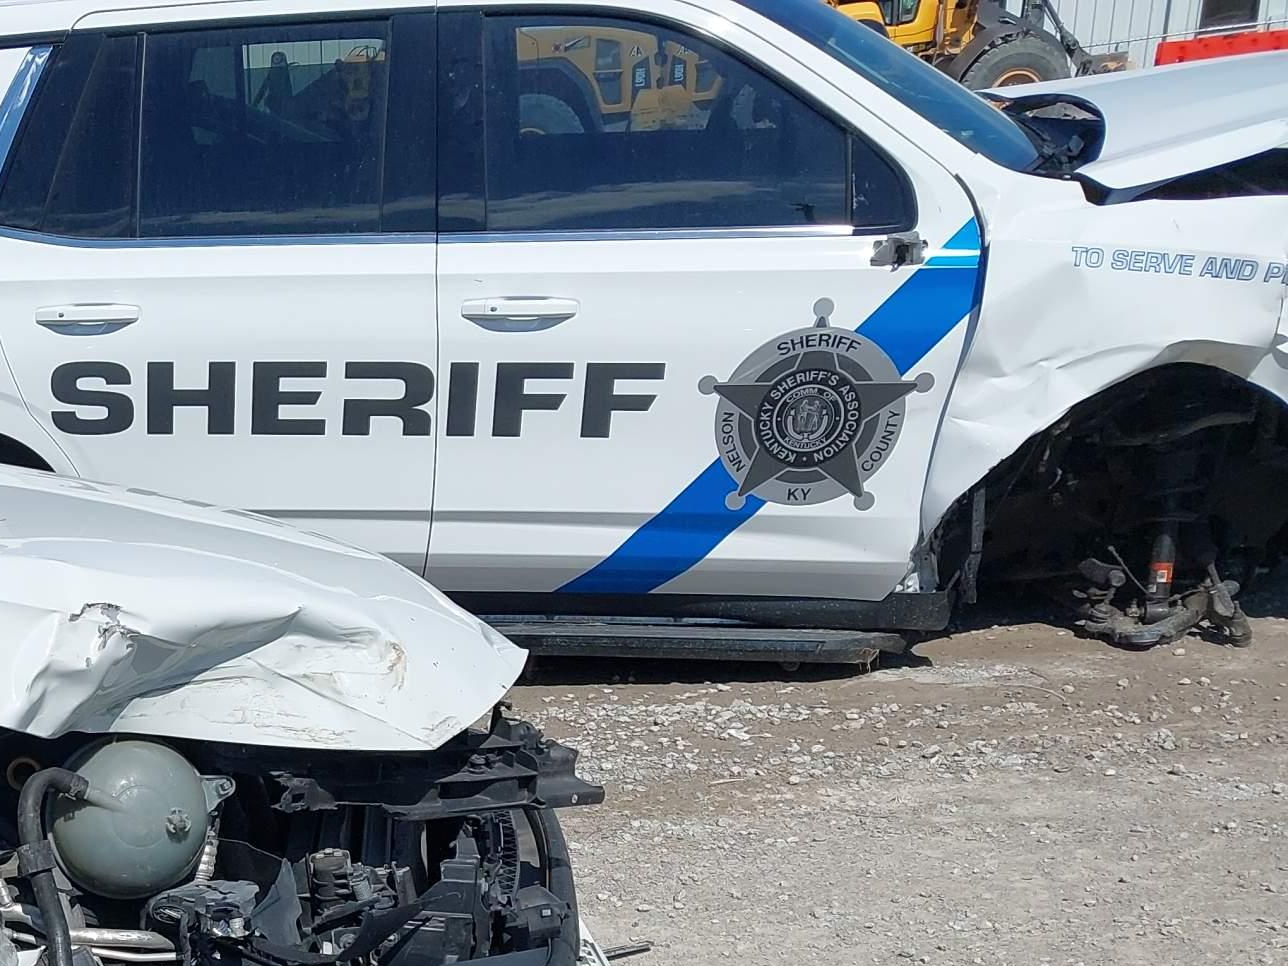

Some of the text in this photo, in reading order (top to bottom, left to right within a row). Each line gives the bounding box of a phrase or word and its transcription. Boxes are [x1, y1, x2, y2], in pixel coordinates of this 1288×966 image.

[1072, 246, 1105, 268] TO
[1111, 249, 1195, 276] SERVE
[1199, 256, 1258, 282] AND
[776, 333, 861, 357] SHERIFF
[50, 360, 666, 439] SHERIFF
[759, 370, 860, 464] KENTUCKY SHERIFF'S ASSOCIATION
[722, 411, 745, 473] NELSON
[784, 436, 826, 449] KENTUCKY
[861, 410, 901, 473] COUNTY
[786, 487, 812, 501] KY
